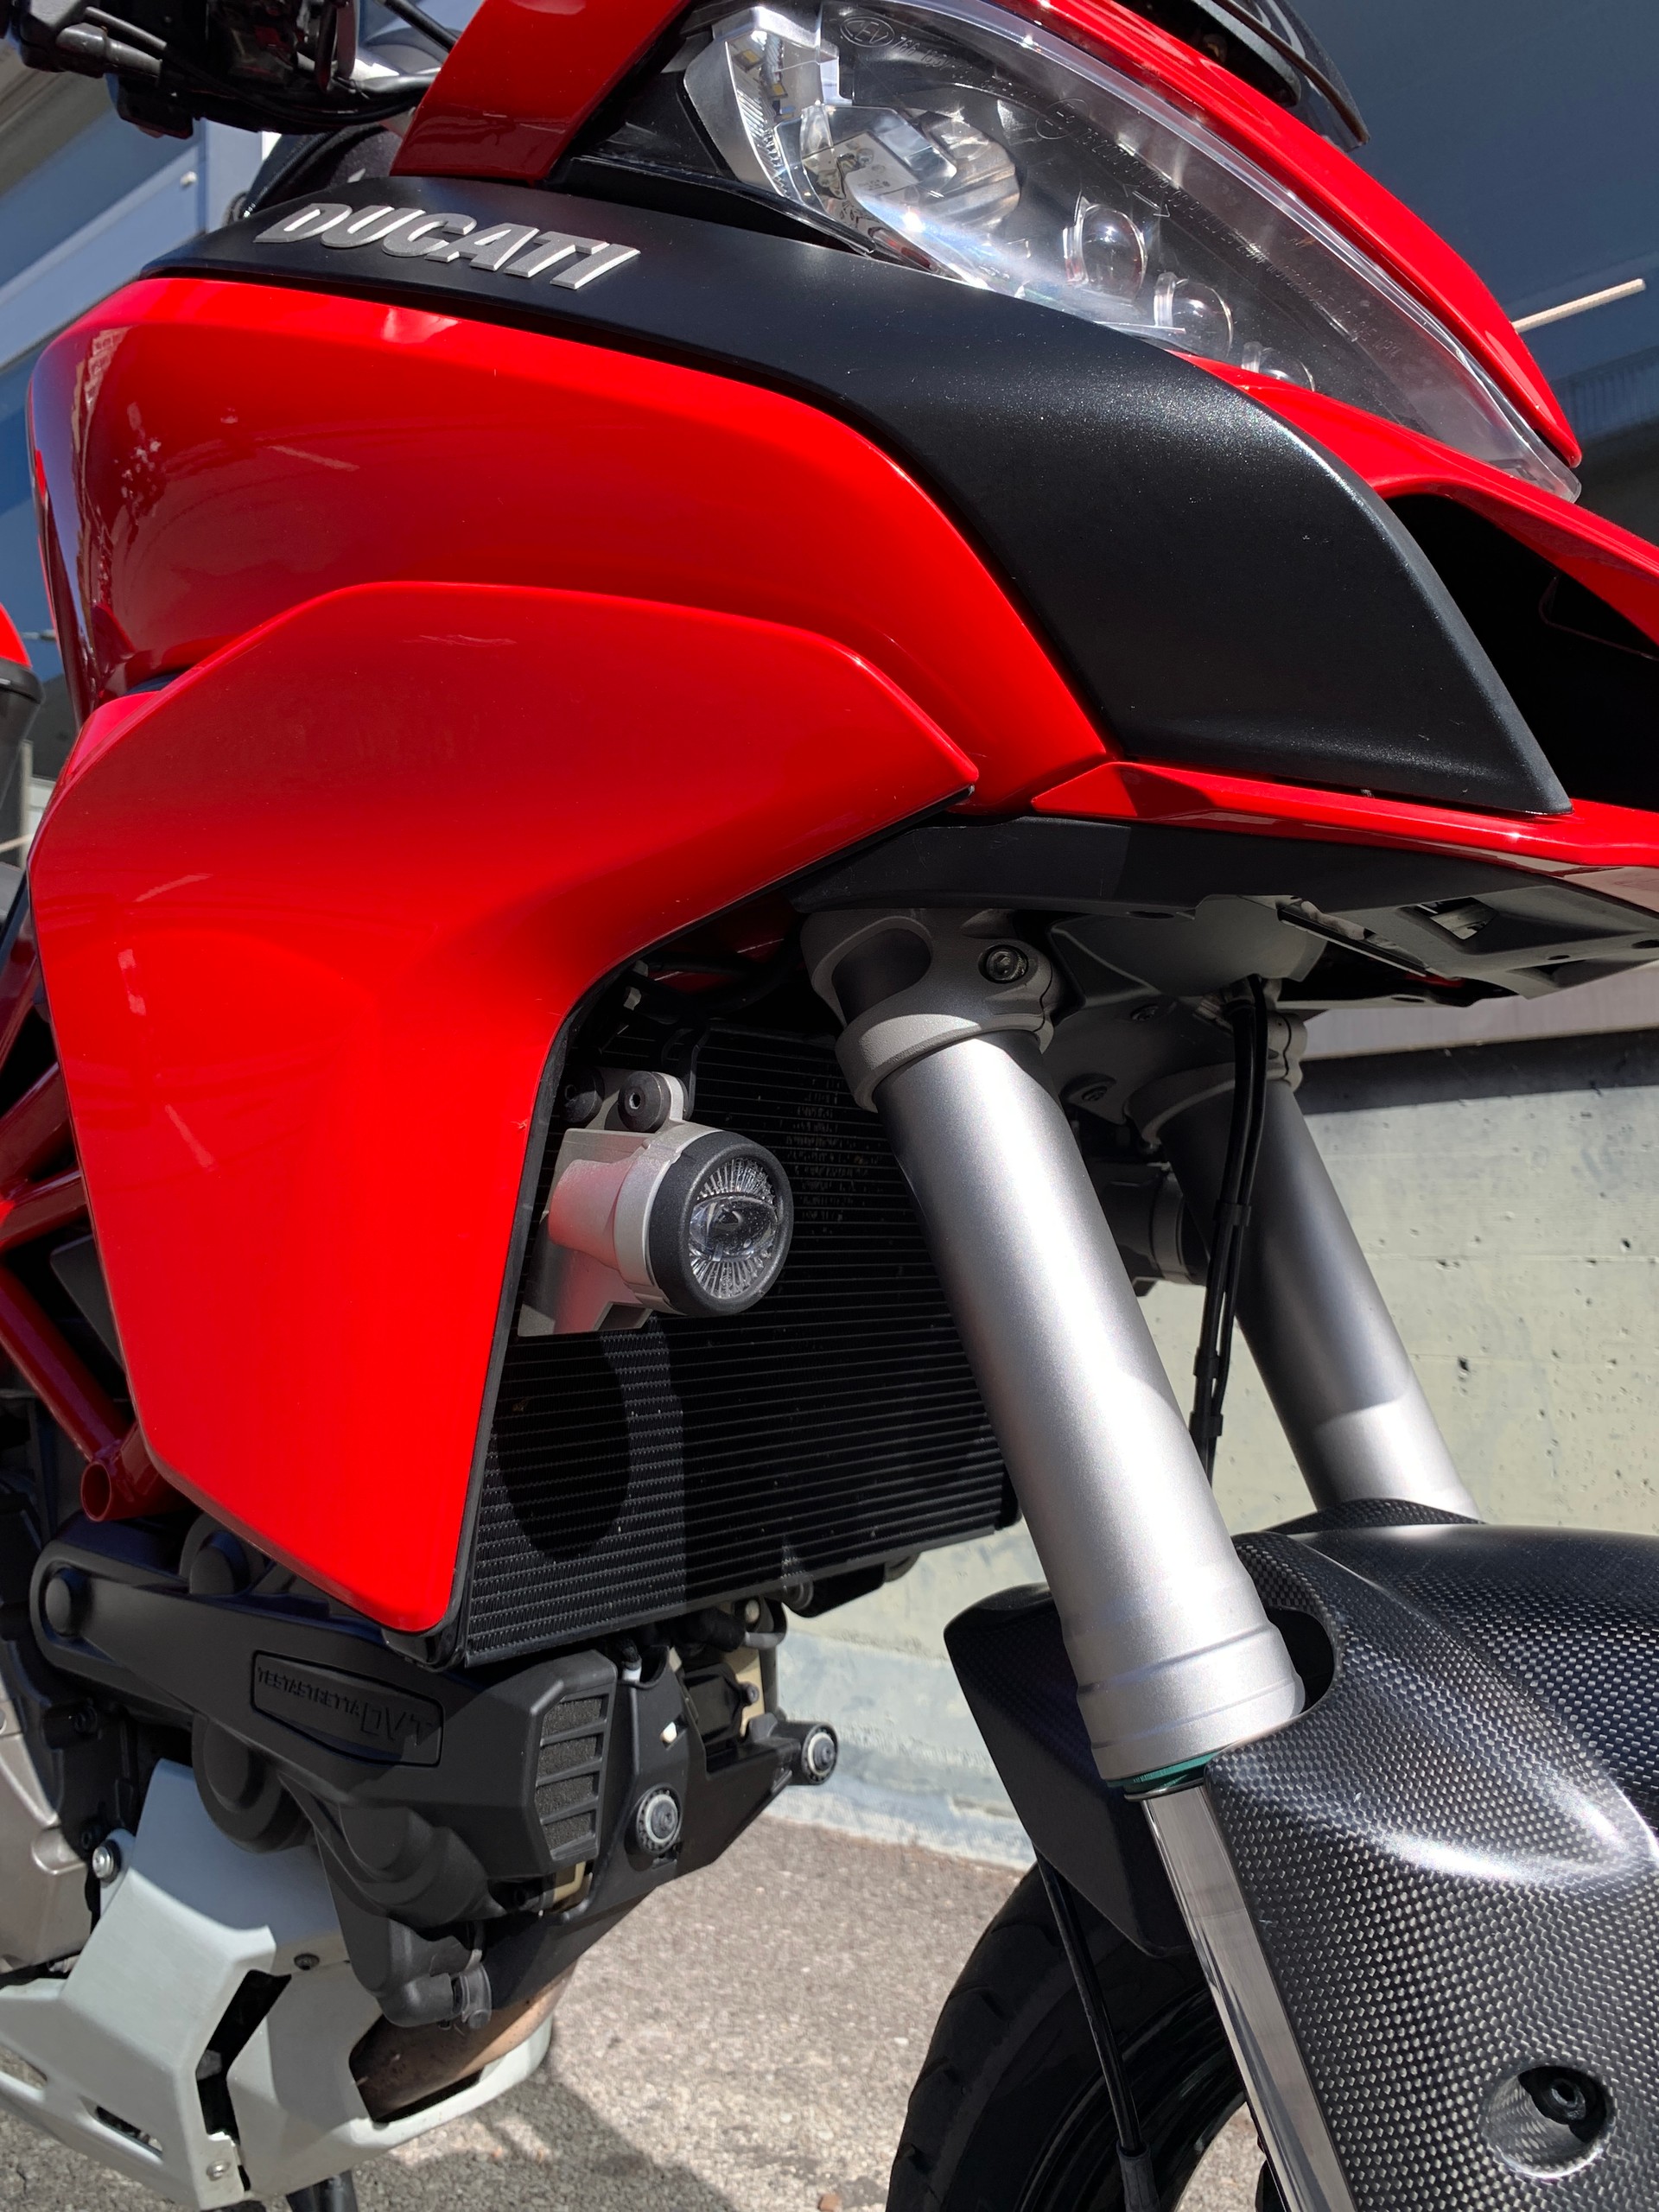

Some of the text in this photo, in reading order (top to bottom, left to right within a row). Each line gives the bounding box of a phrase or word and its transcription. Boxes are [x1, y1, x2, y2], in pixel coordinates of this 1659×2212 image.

[253, 203, 640, 289] DUCATI
[257, 1667, 433, 1746] TESTASTRETTA DVT
